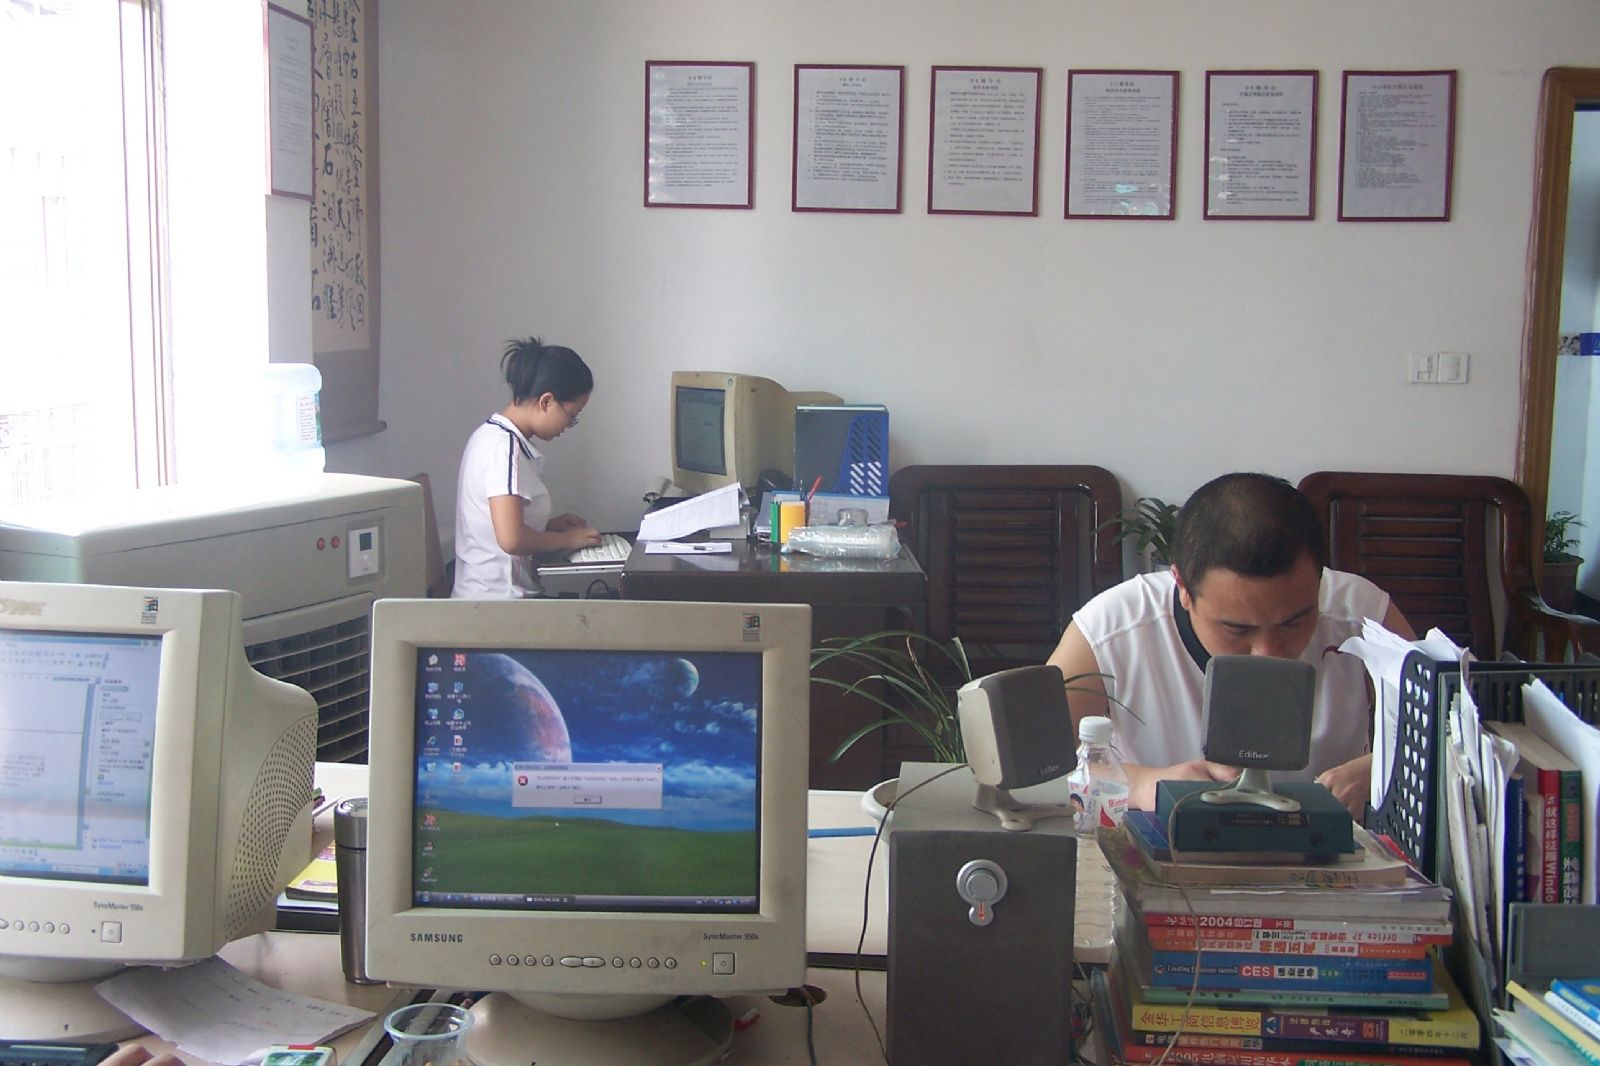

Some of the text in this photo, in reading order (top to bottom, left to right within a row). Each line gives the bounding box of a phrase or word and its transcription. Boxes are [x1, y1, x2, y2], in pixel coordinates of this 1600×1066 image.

[410, 932, 464, 943] SAMSUNG
[703, 931, 743, 942] SyncMaster
[1242, 965, 1270, 977] CES
